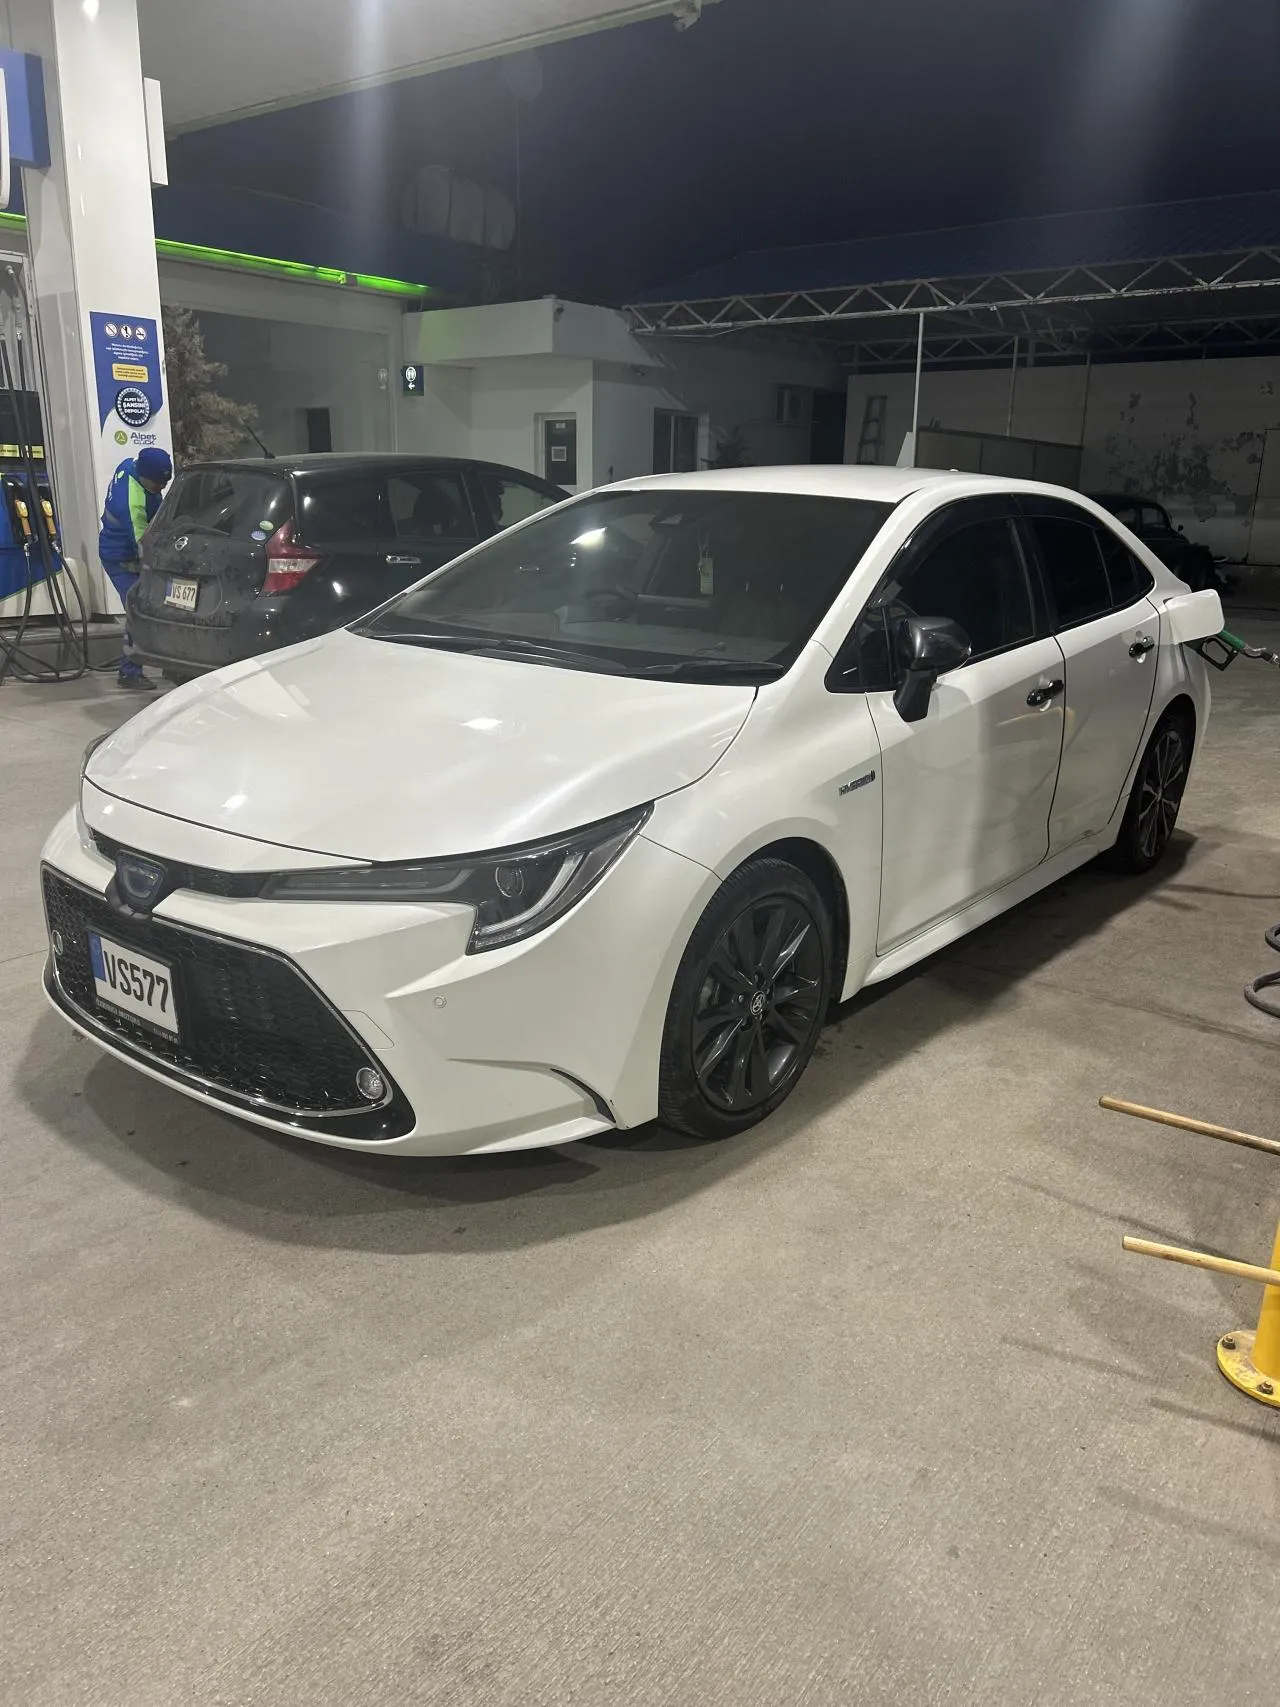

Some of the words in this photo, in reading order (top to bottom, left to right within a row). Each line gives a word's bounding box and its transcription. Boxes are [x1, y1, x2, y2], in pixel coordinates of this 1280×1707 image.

[130, 432, 157, 440] Alpet
[172, 585, 181, 599] VS
[182, 586, 196, 601] 677
[103, 950, 169, 1013] VS577
